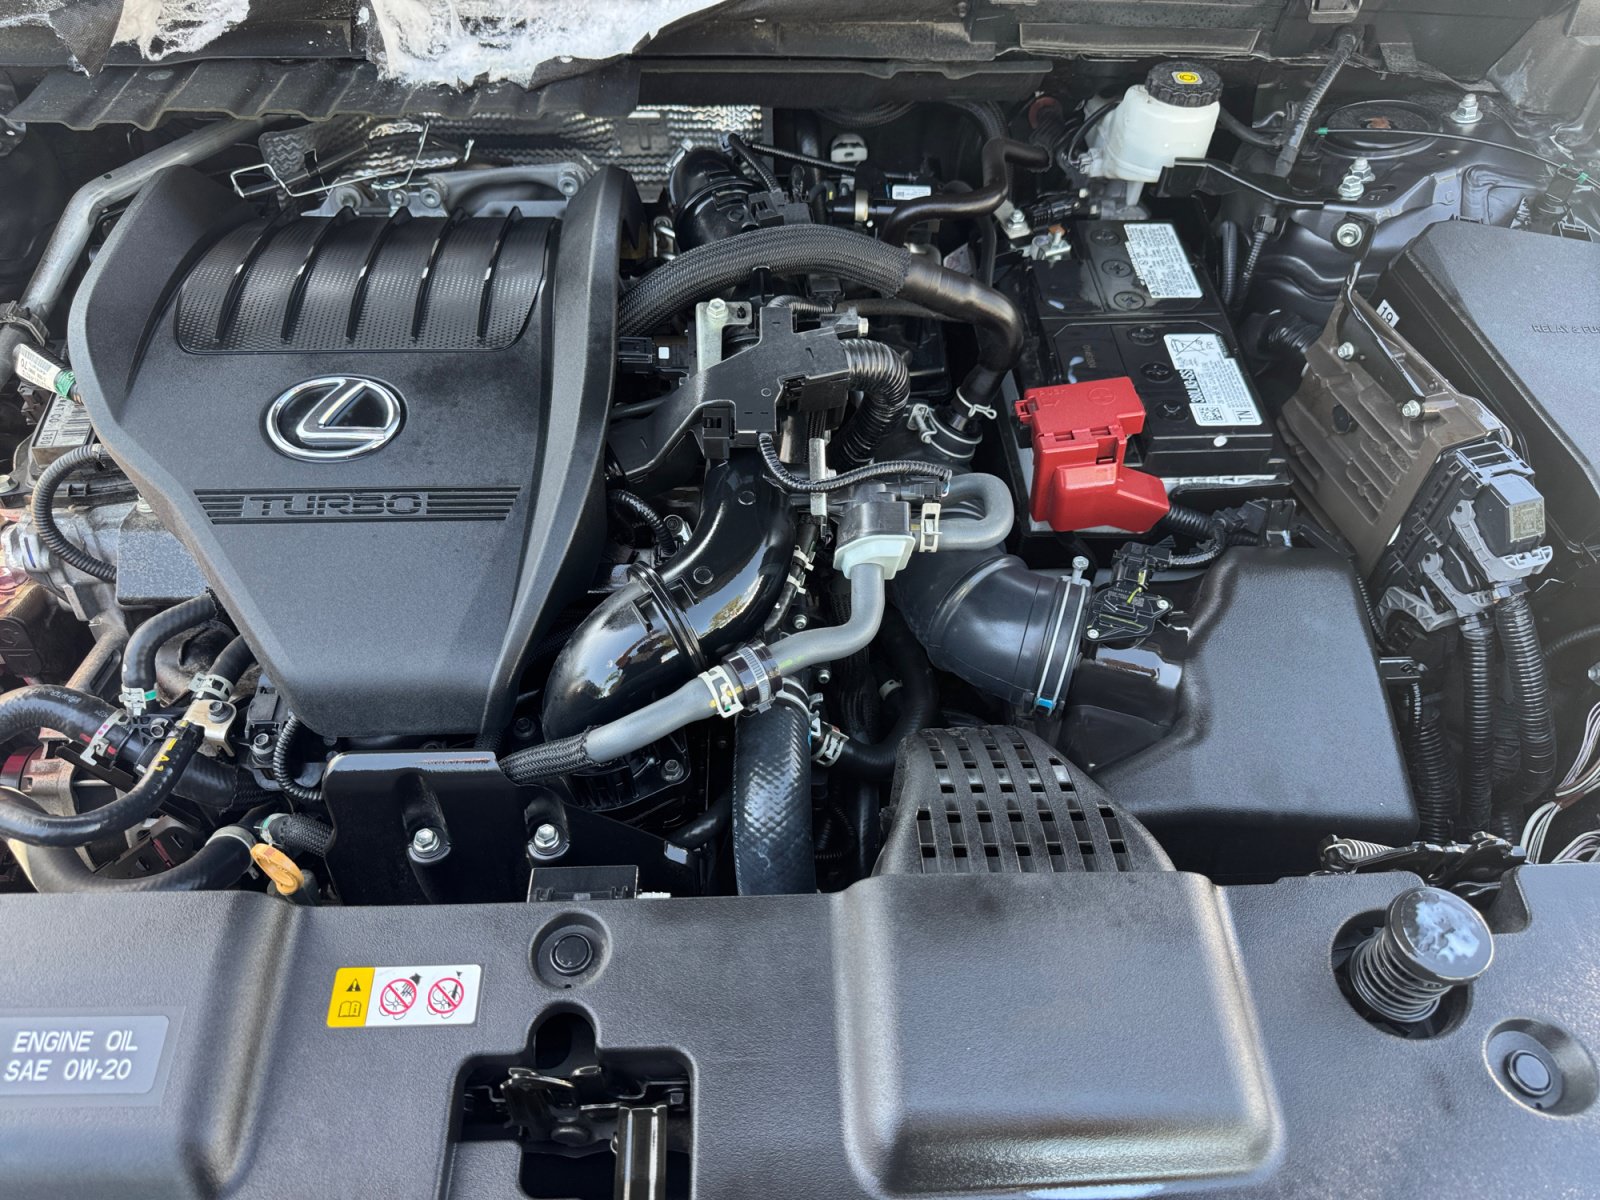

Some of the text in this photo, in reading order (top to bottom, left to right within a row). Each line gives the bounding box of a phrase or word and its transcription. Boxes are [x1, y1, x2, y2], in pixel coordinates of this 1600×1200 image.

[1380, 306, 1394, 323] 19
[1531, 324, 1569, 334] RELAY
[1235, 410, 1253, 421] TN
[248, 493, 424, 517] TURBO
[12, 1030, 138, 1053] ENGINE OIL
[3, 1058, 132, 1081] SAE 0W-20
